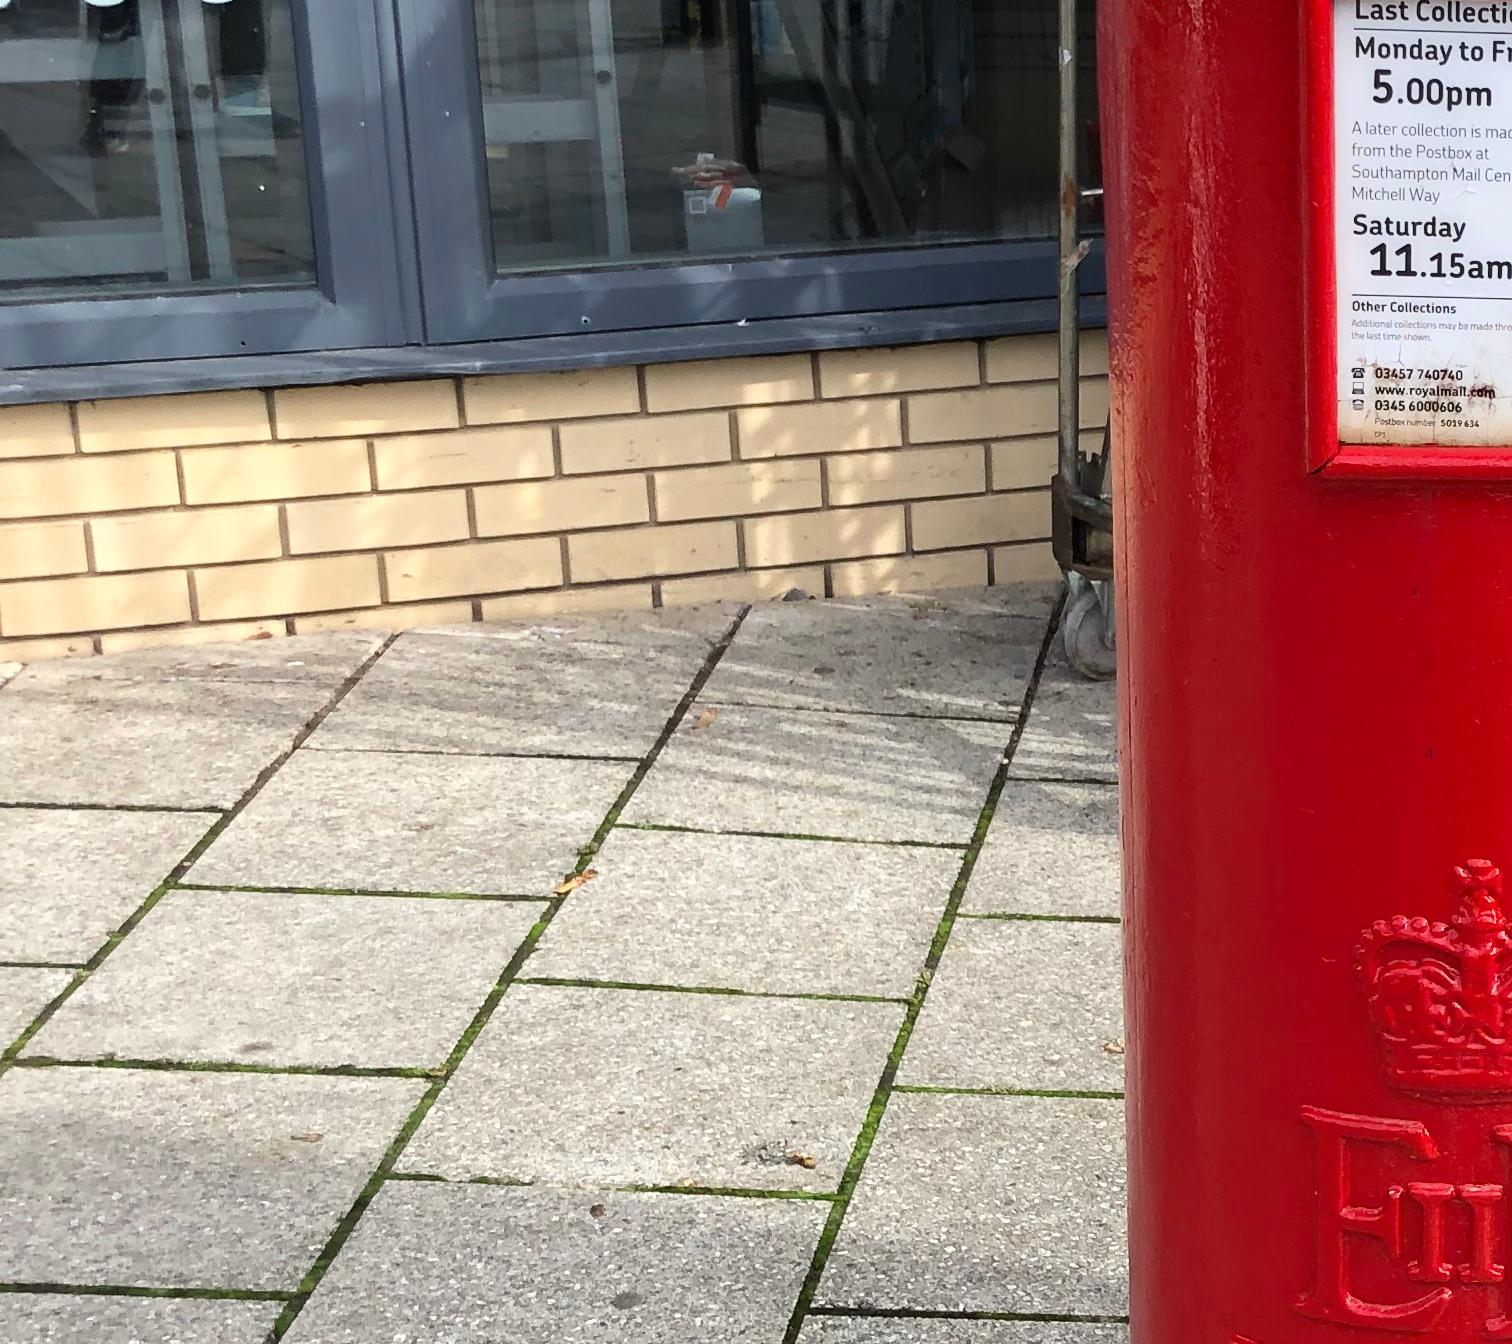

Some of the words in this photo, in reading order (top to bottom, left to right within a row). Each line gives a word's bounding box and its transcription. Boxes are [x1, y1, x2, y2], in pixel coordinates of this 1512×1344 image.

[1355, 36, 1452, 65] Monday
[1460, 42, 1483, 61] to
[1372, 69, 1492, 111] 5.00pm
[1352, 122, 1362, 135] A
[1365, 122, 1397, 136] later
[1401, 123, 1467, 138] collection
[1471, 125, 1481, 138] is
[1352, 143, 1385, 157] from
[1390, 144, 1412, 158] the
[1417, 145, 1472, 160] Postbox
[1476, 148, 1489, 160] at
[1352, 165, 1448, 182] Southampton
[1453, 167, 1481, 182] Mail
[1352, 187, 1405, 201] Mitchell
[1410, 188, 1440, 204] Way
[1353, 214, 1466, 242] Saturday
[1370, 243, 1512, 280] 11.15am
[1352, 301, 1386, 312] Other
[1390, 302, 1456, 314] Collections
[1352, 319, 1392, 328] Additional
[1394, 320, 1437, 330] collections
[1439, 322, 1456, 331] may
[1458, 322, 1468, 330] be
[1470, 322, 1493, 331] made
[1351, 332, 1365, 340] the
[1367, 332, 1381, 340] last
[1383, 332, 1401, 341] time
[1403, 333, 1432, 342] shown.
[1375, 368, 1413, 379] 03457
[1418, 369, 1463, 380] 740740
[1375, 385, 1496, 399] www.royalmail.com
[1375, 400, 1405, 411] 0345
[1409, 401, 1462, 412] 6000606
[1375, 417, 1405, 425] Postbox
[1464, 419, 1479, 427] 634
